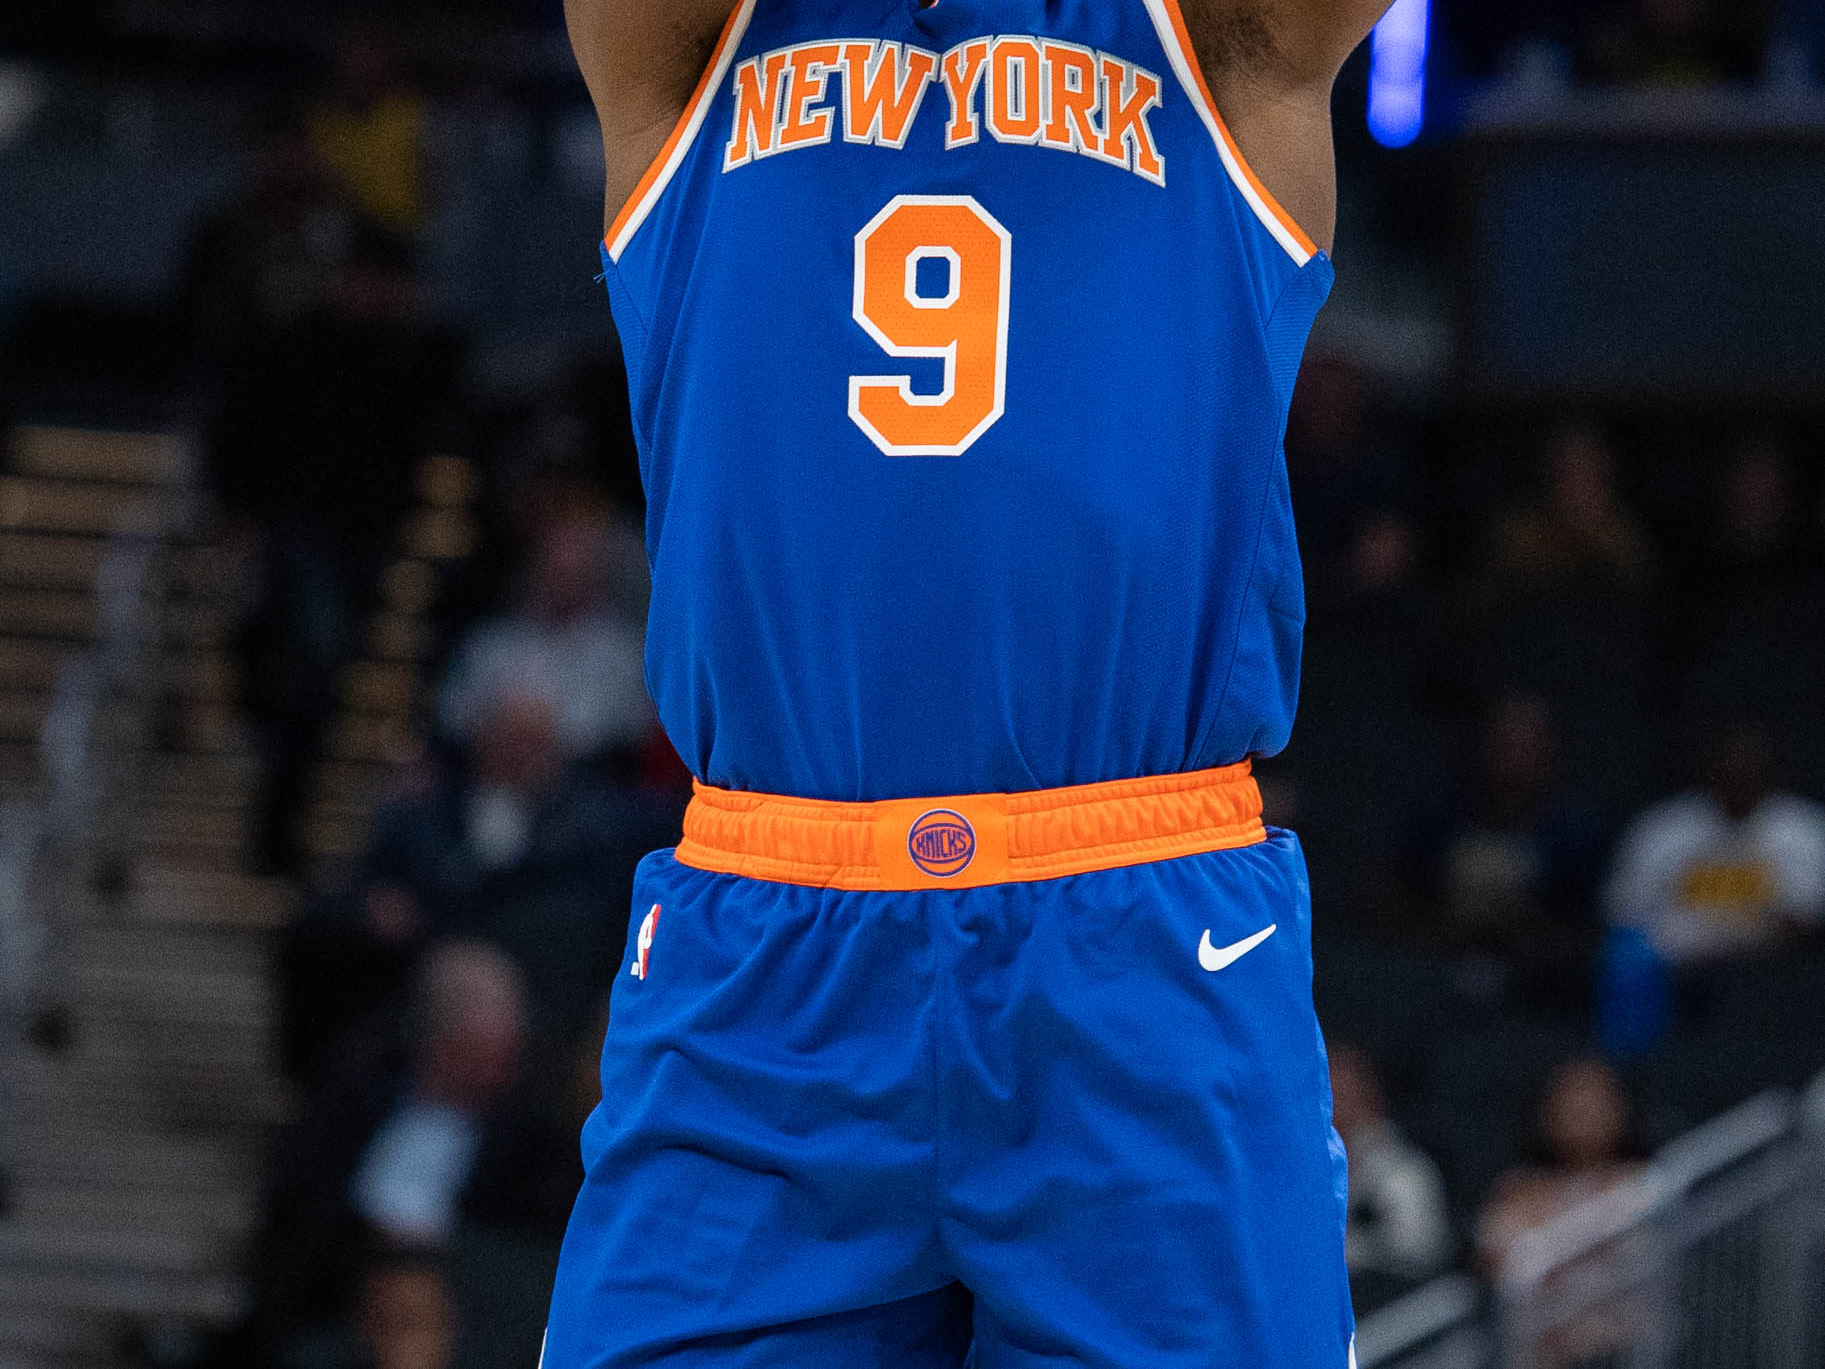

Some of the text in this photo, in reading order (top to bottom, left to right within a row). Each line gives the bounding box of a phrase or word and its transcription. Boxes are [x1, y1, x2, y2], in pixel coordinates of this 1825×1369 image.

[722, 35, 1166, 187] NEW YORK
[848, 194, 1012, 456] 9
[916, 828, 967, 858] KNICKS
